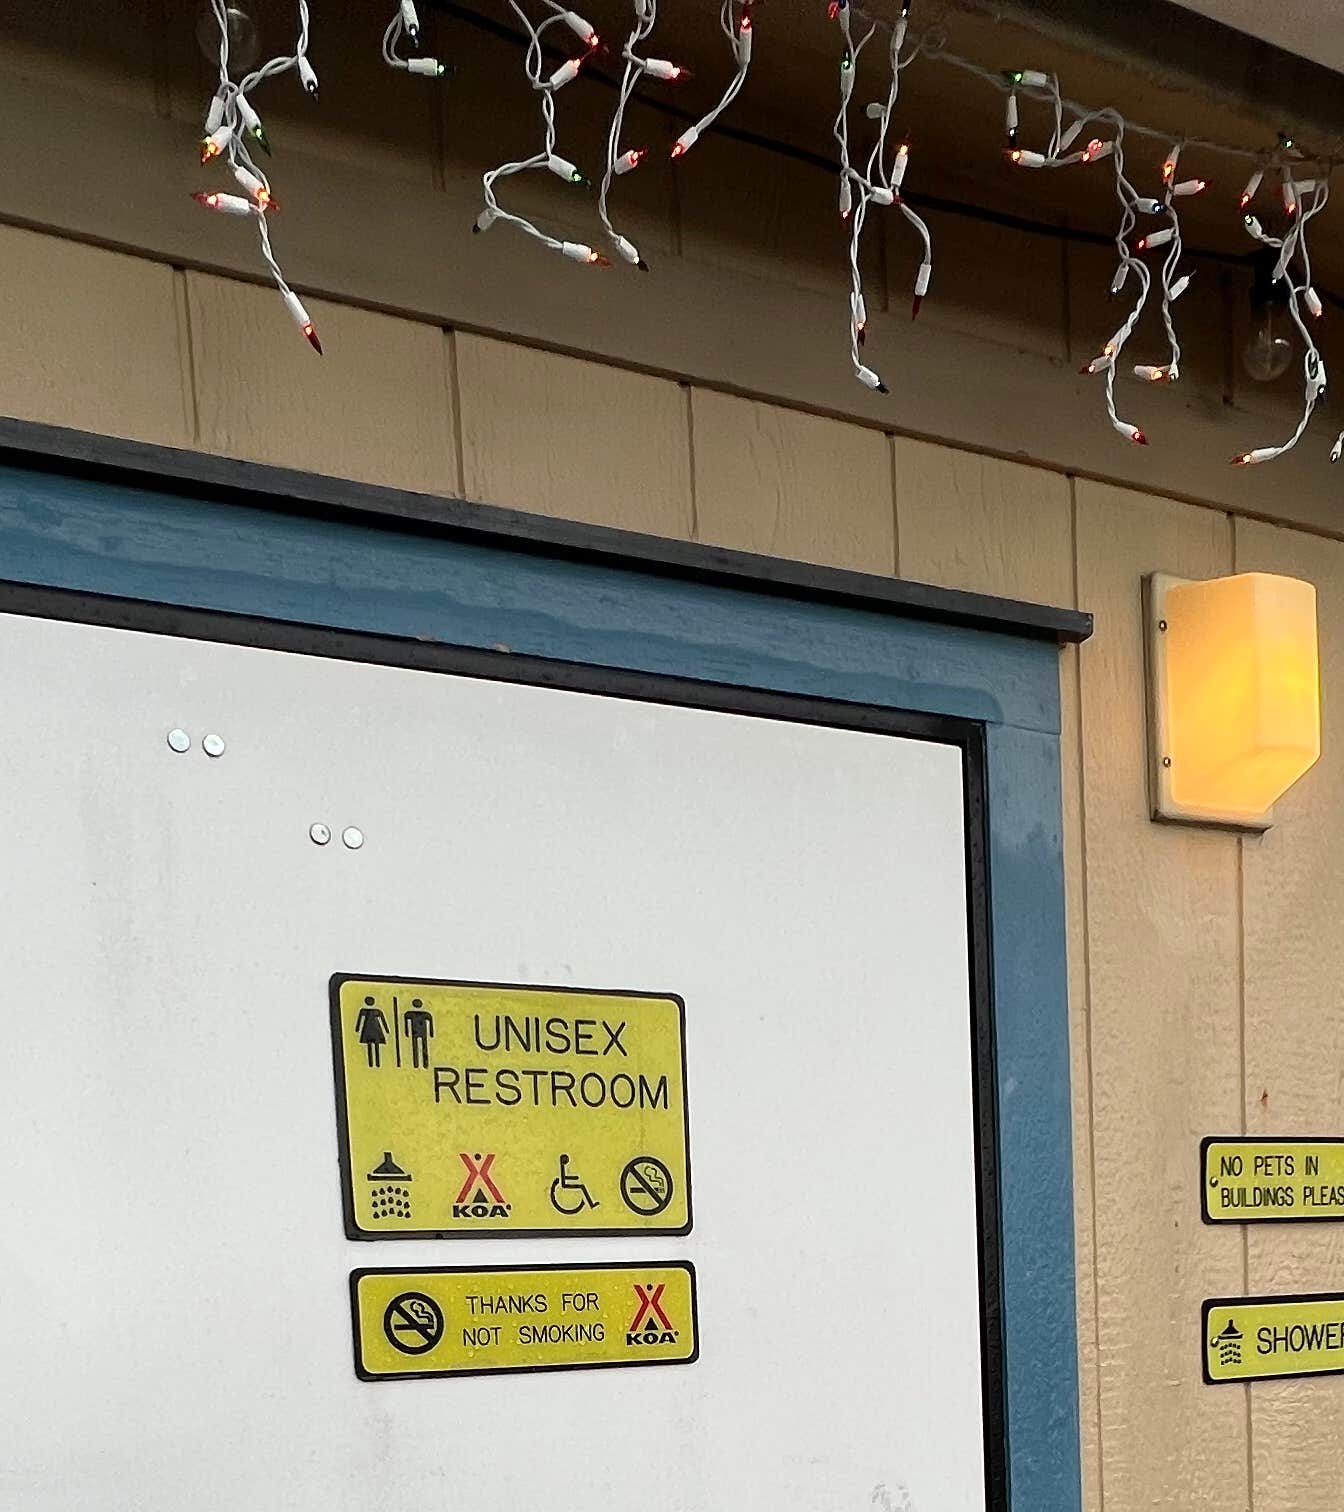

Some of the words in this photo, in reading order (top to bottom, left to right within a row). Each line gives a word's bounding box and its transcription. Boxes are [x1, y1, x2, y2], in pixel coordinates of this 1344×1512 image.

[473, 1014, 628, 1057] UNISEX
[433, 1067, 669, 1110] RESTROOM
[1219, 1155, 1243, 1177] NO
[1253, 1155, 1294, 1176] PETS
[1305, 1155, 1319, 1176] IN
[1220, 1184, 1294, 1208] BUILDINGS
[452, 1204, 511, 1218] KOA
[466, 1295, 547, 1314] THANKS
[562, 1293, 599, 1311] FOR
[463, 1328, 500, 1346] NOT
[519, 1323, 605, 1344] SMOKING
[626, 1331, 679, 1346] KOA
